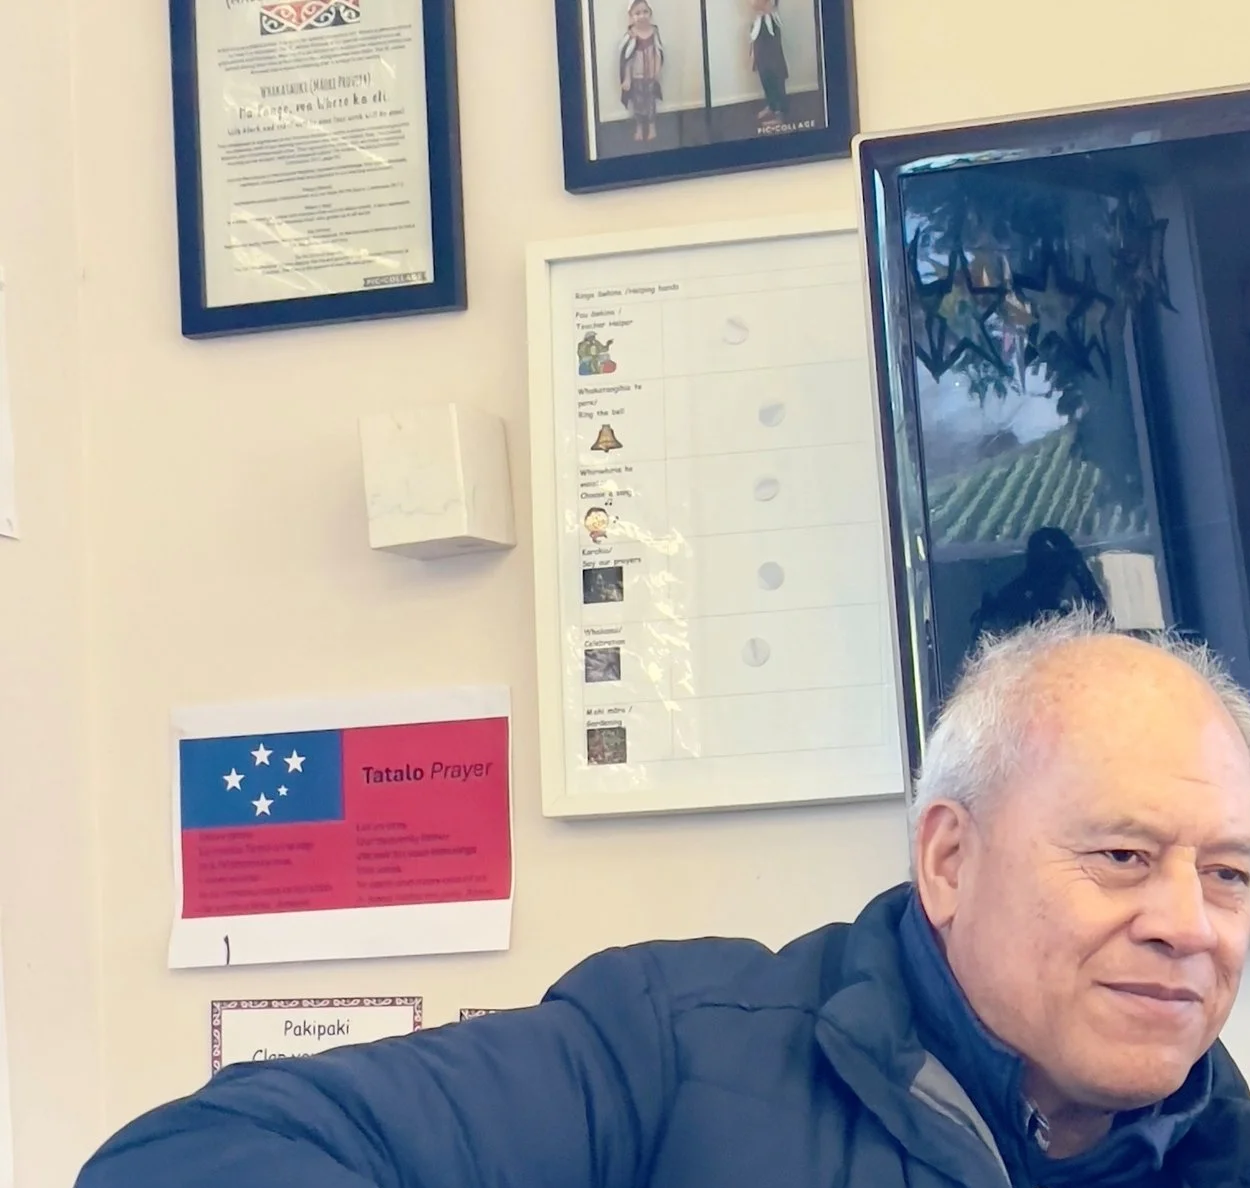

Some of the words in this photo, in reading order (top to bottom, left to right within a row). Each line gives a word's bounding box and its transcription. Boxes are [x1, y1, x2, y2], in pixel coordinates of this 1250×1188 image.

[362, 765, 424, 785] Tatalo
[430, 760, 494, 782] Prayer
[283, 1019, 350, 1041] Pakipaki
